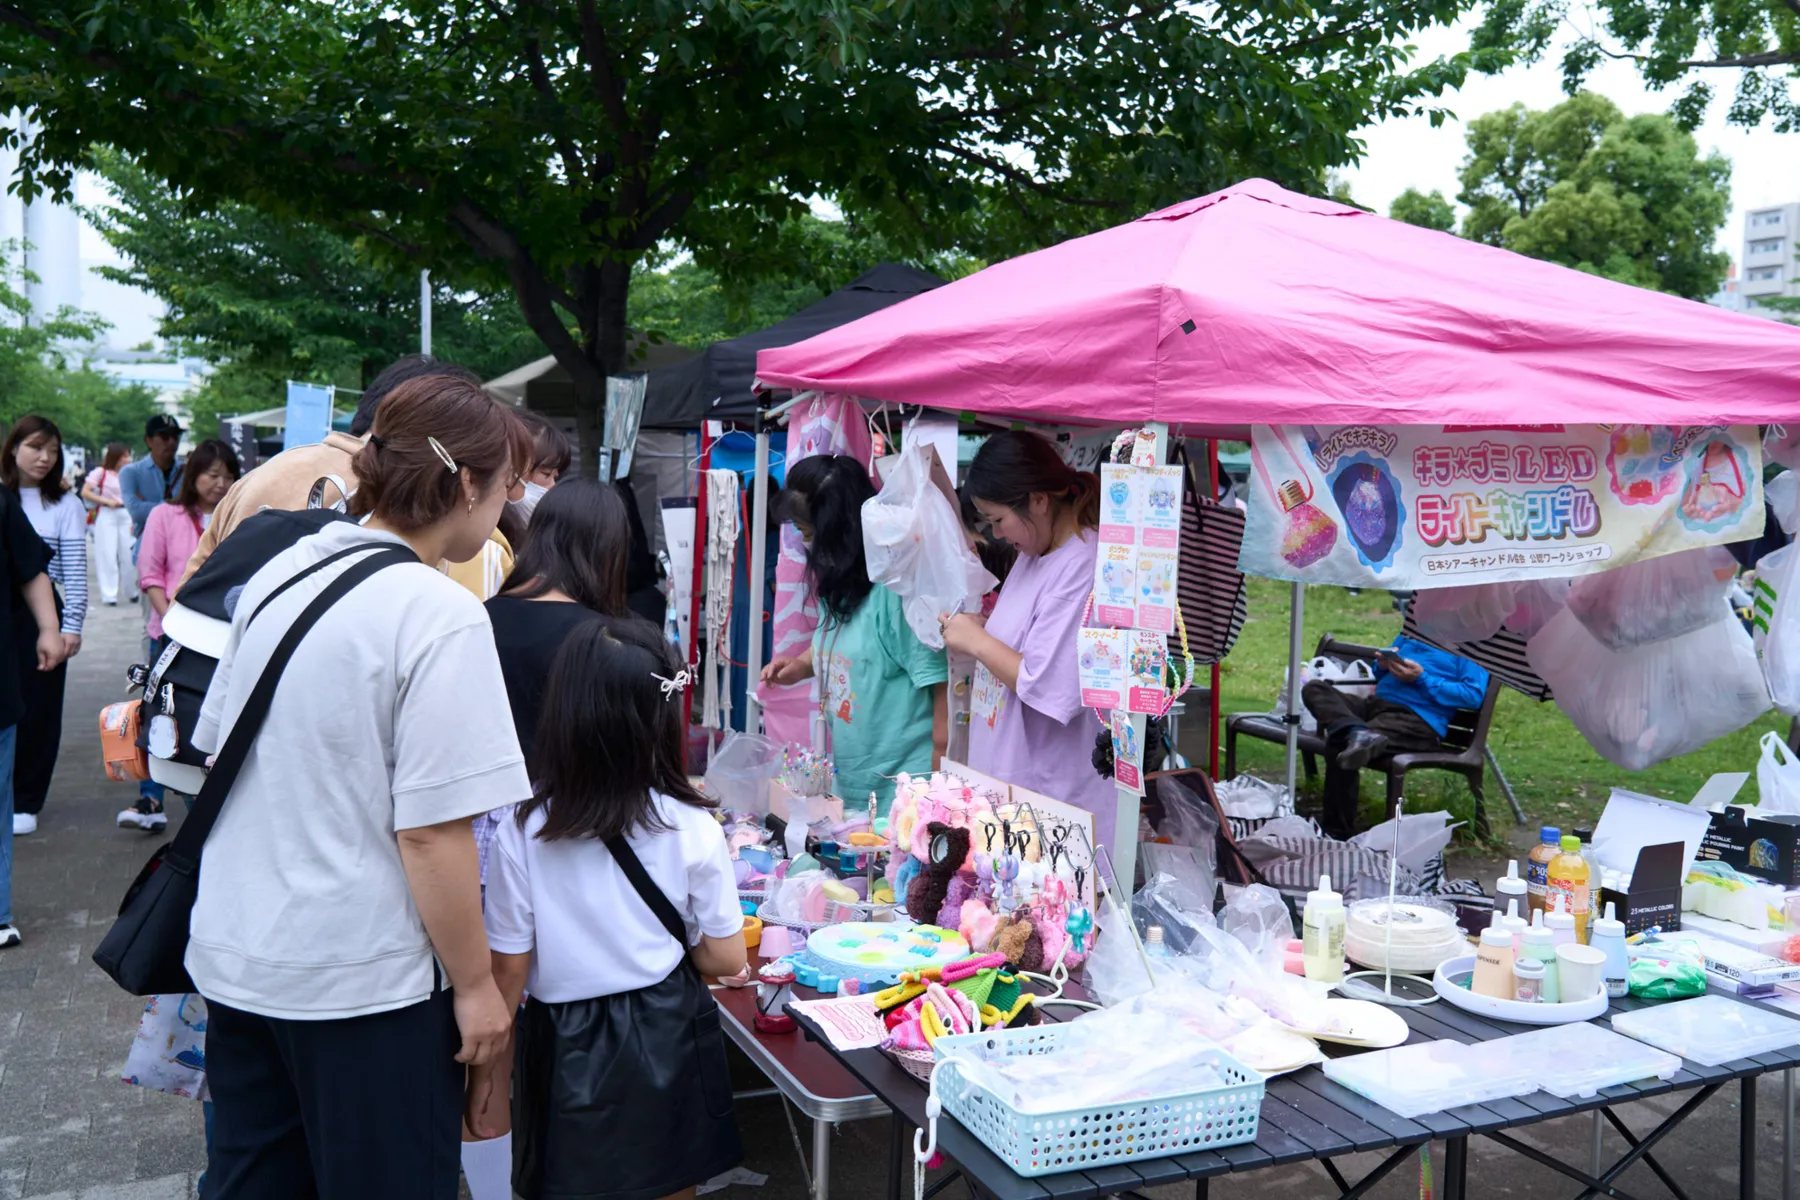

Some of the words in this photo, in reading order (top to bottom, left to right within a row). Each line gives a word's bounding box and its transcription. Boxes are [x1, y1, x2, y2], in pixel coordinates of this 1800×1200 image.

[1417, 487, 1601, 546] ライトキャンドル
[1709, 834, 1732, 843] METALLIC
[1710, 840, 1730, 849] POURING
[1658, 903, 1674, 911] COLORS
[1728, 968, 1740, 978] 120
